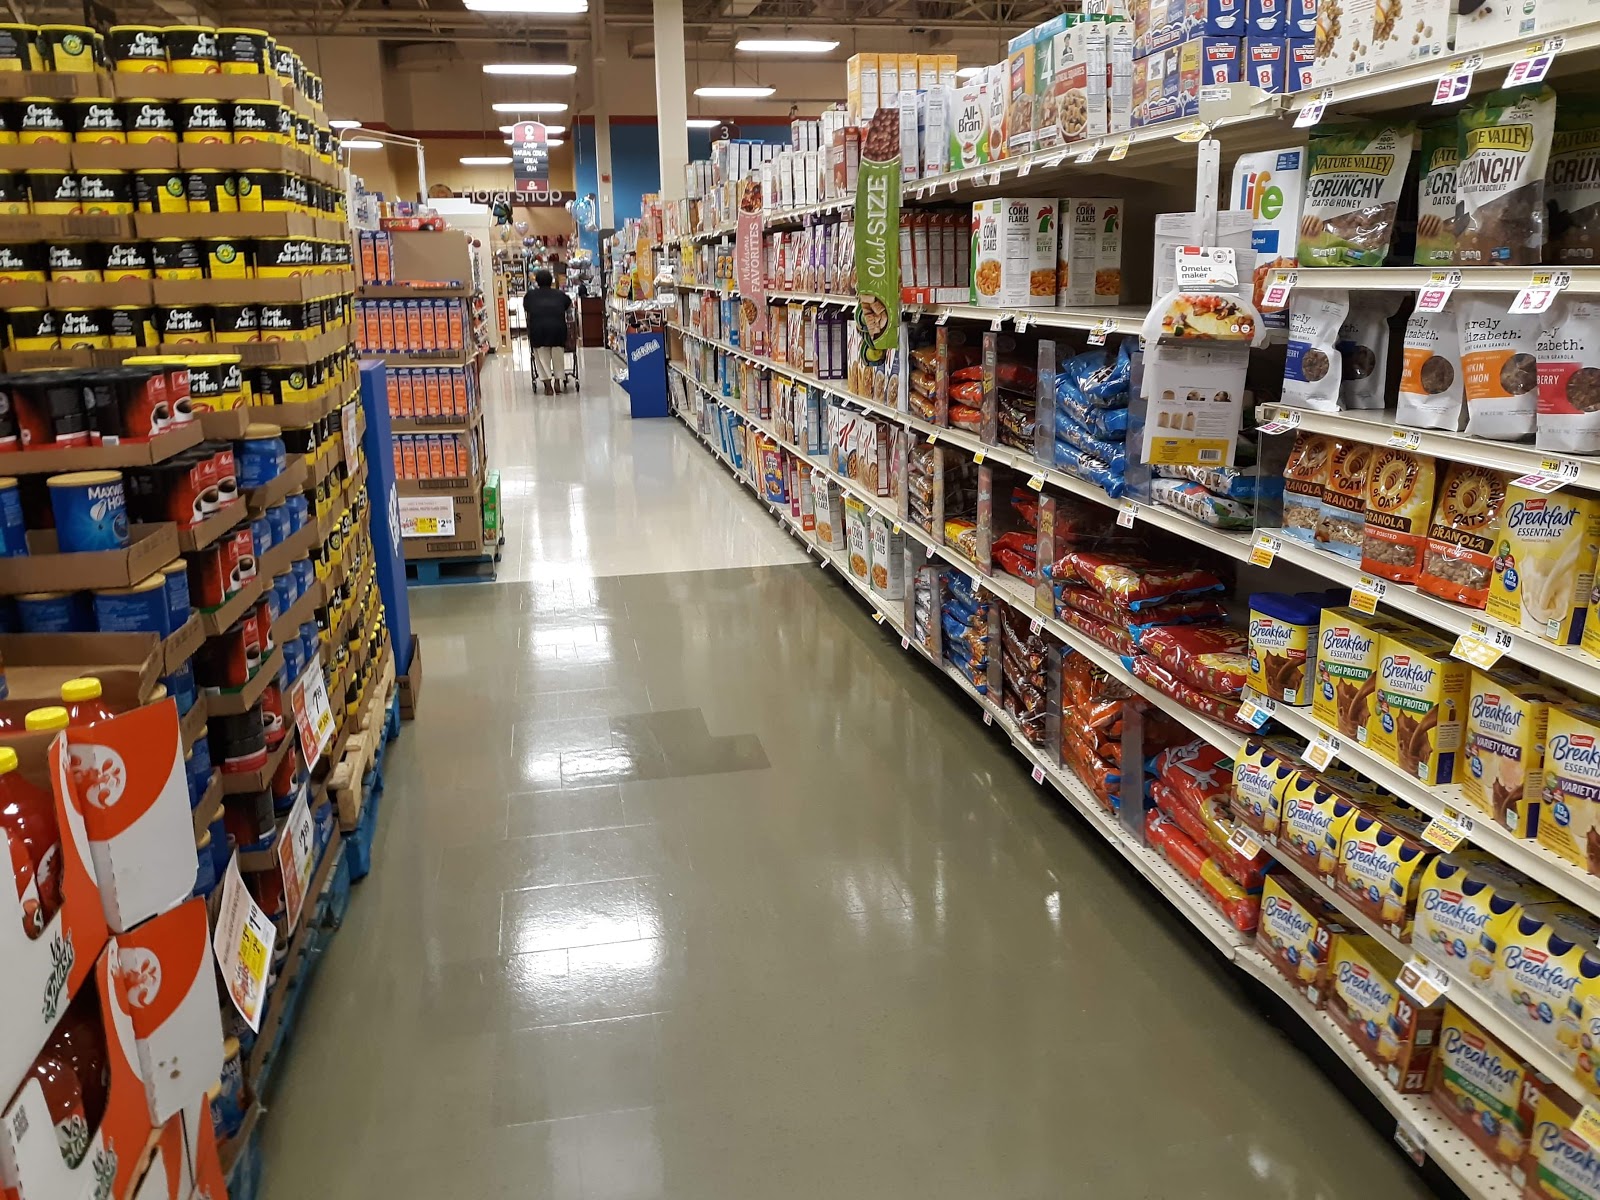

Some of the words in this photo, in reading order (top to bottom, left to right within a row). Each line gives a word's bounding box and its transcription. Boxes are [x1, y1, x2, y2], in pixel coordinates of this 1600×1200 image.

[1040, 39, 1054, 87] 4
[1215, 70, 1227, 86] 8
[1259, 70, 1271, 85] 8
[1301, 71, 1313, 85] 8
[963, 105, 979, 121] All-
[720, 125, 730, 140] 3
[958, 118, 981, 134] Bran
[1488, 126, 1530, 148] VALLEY
[1313, 156, 1352, 172] NATURE
[1354, 156, 1391, 173] VALLEY
[1432, 149, 1457, 167] NATU
[1552, 158, 1600, 184] CRUN
[461, 185, 511, 203] Floral
[516, 188, 562, 207] shop
[1240, 170, 1284, 221] life
[1312, 178, 1385, 199] CRUNCHY
[866, 173, 889, 236] SIZE
[1008, 206, 1029, 216] CORN
[1076, 205, 1096, 216] CORN
[1312, 198, 1329, 207] OATS
[1336, 199, 1361, 209] HONEY
[1008, 215, 1029, 223] FLAKES
[1076, 215, 1096, 223] FLAKES
[983, 224, 998, 239] CORN
[982, 238, 998, 252] FLAKES
[1251, 238, 1266, 248] iginal
[749, 221, 761, 294] FAVORITES
[865, 238, 887, 279] Club
[1181, 265, 1212, 273] Omelet
[1181, 271, 1208, 279] maker
[1372, 450, 1395, 483] HONEY
[1562, 464, 1579, 478] 7.19
[88, 483, 124, 501] MAXWE
[1377, 493, 1402, 508] OATS
[1365, 510, 1405, 530] GRANOLA
[1452, 511, 1486, 527] OATS
[1506, 502, 1581, 528] Breakfast
[1432, 526, 1487, 551] GRANOLA
[1517, 527, 1563, 538] ESSENTIALS
[1250, 621, 1296, 640] Breakfast
[1495, 631, 1512, 648] 5.49
[1256, 637, 1286, 648] ESSENTIALS
[1321, 629, 1374, 654] Breakfast
[1330, 649, 1363, 661] ESSENTIALS
[1327, 664, 1343, 675] HIGH
[1343, 666, 1369, 679] PROTEIN
[1379, 656, 1436, 684] Breakfast
[1389, 678, 1424, 692] ESSENTIALS
[1387, 694, 1402, 706] HIGH
[1402, 697, 1430, 712] PROTEIN
[1470, 694, 1525, 727] Breakfast
[1479, 719, 1513, 736] ESSENTIALS
[1476, 736, 1500, 753] VARIETY
[1501, 743, 1519, 758] PACK
[1549, 734, 1600, 765] Break
[1235, 763, 1277, 791] Breakfast
[1561, 779, 1597, 800] VARIETY
[1285, 799, 1335, 829] Breakfast
[1343, 840, 1400, 875] Breakfast
[1264, 896, 1314, 935] Breakfast
[1422, 888, 1492, 929] Breakfast
[1316, 927, 1330, 949] 12
[1503, 945, 1582, 993] Breakfast
[1338, 960, 1393, 1006] Breakfast
[1398, 1000, 1413, 1025] 12
[1442, 1026, 1520, 1085] Breakfast
